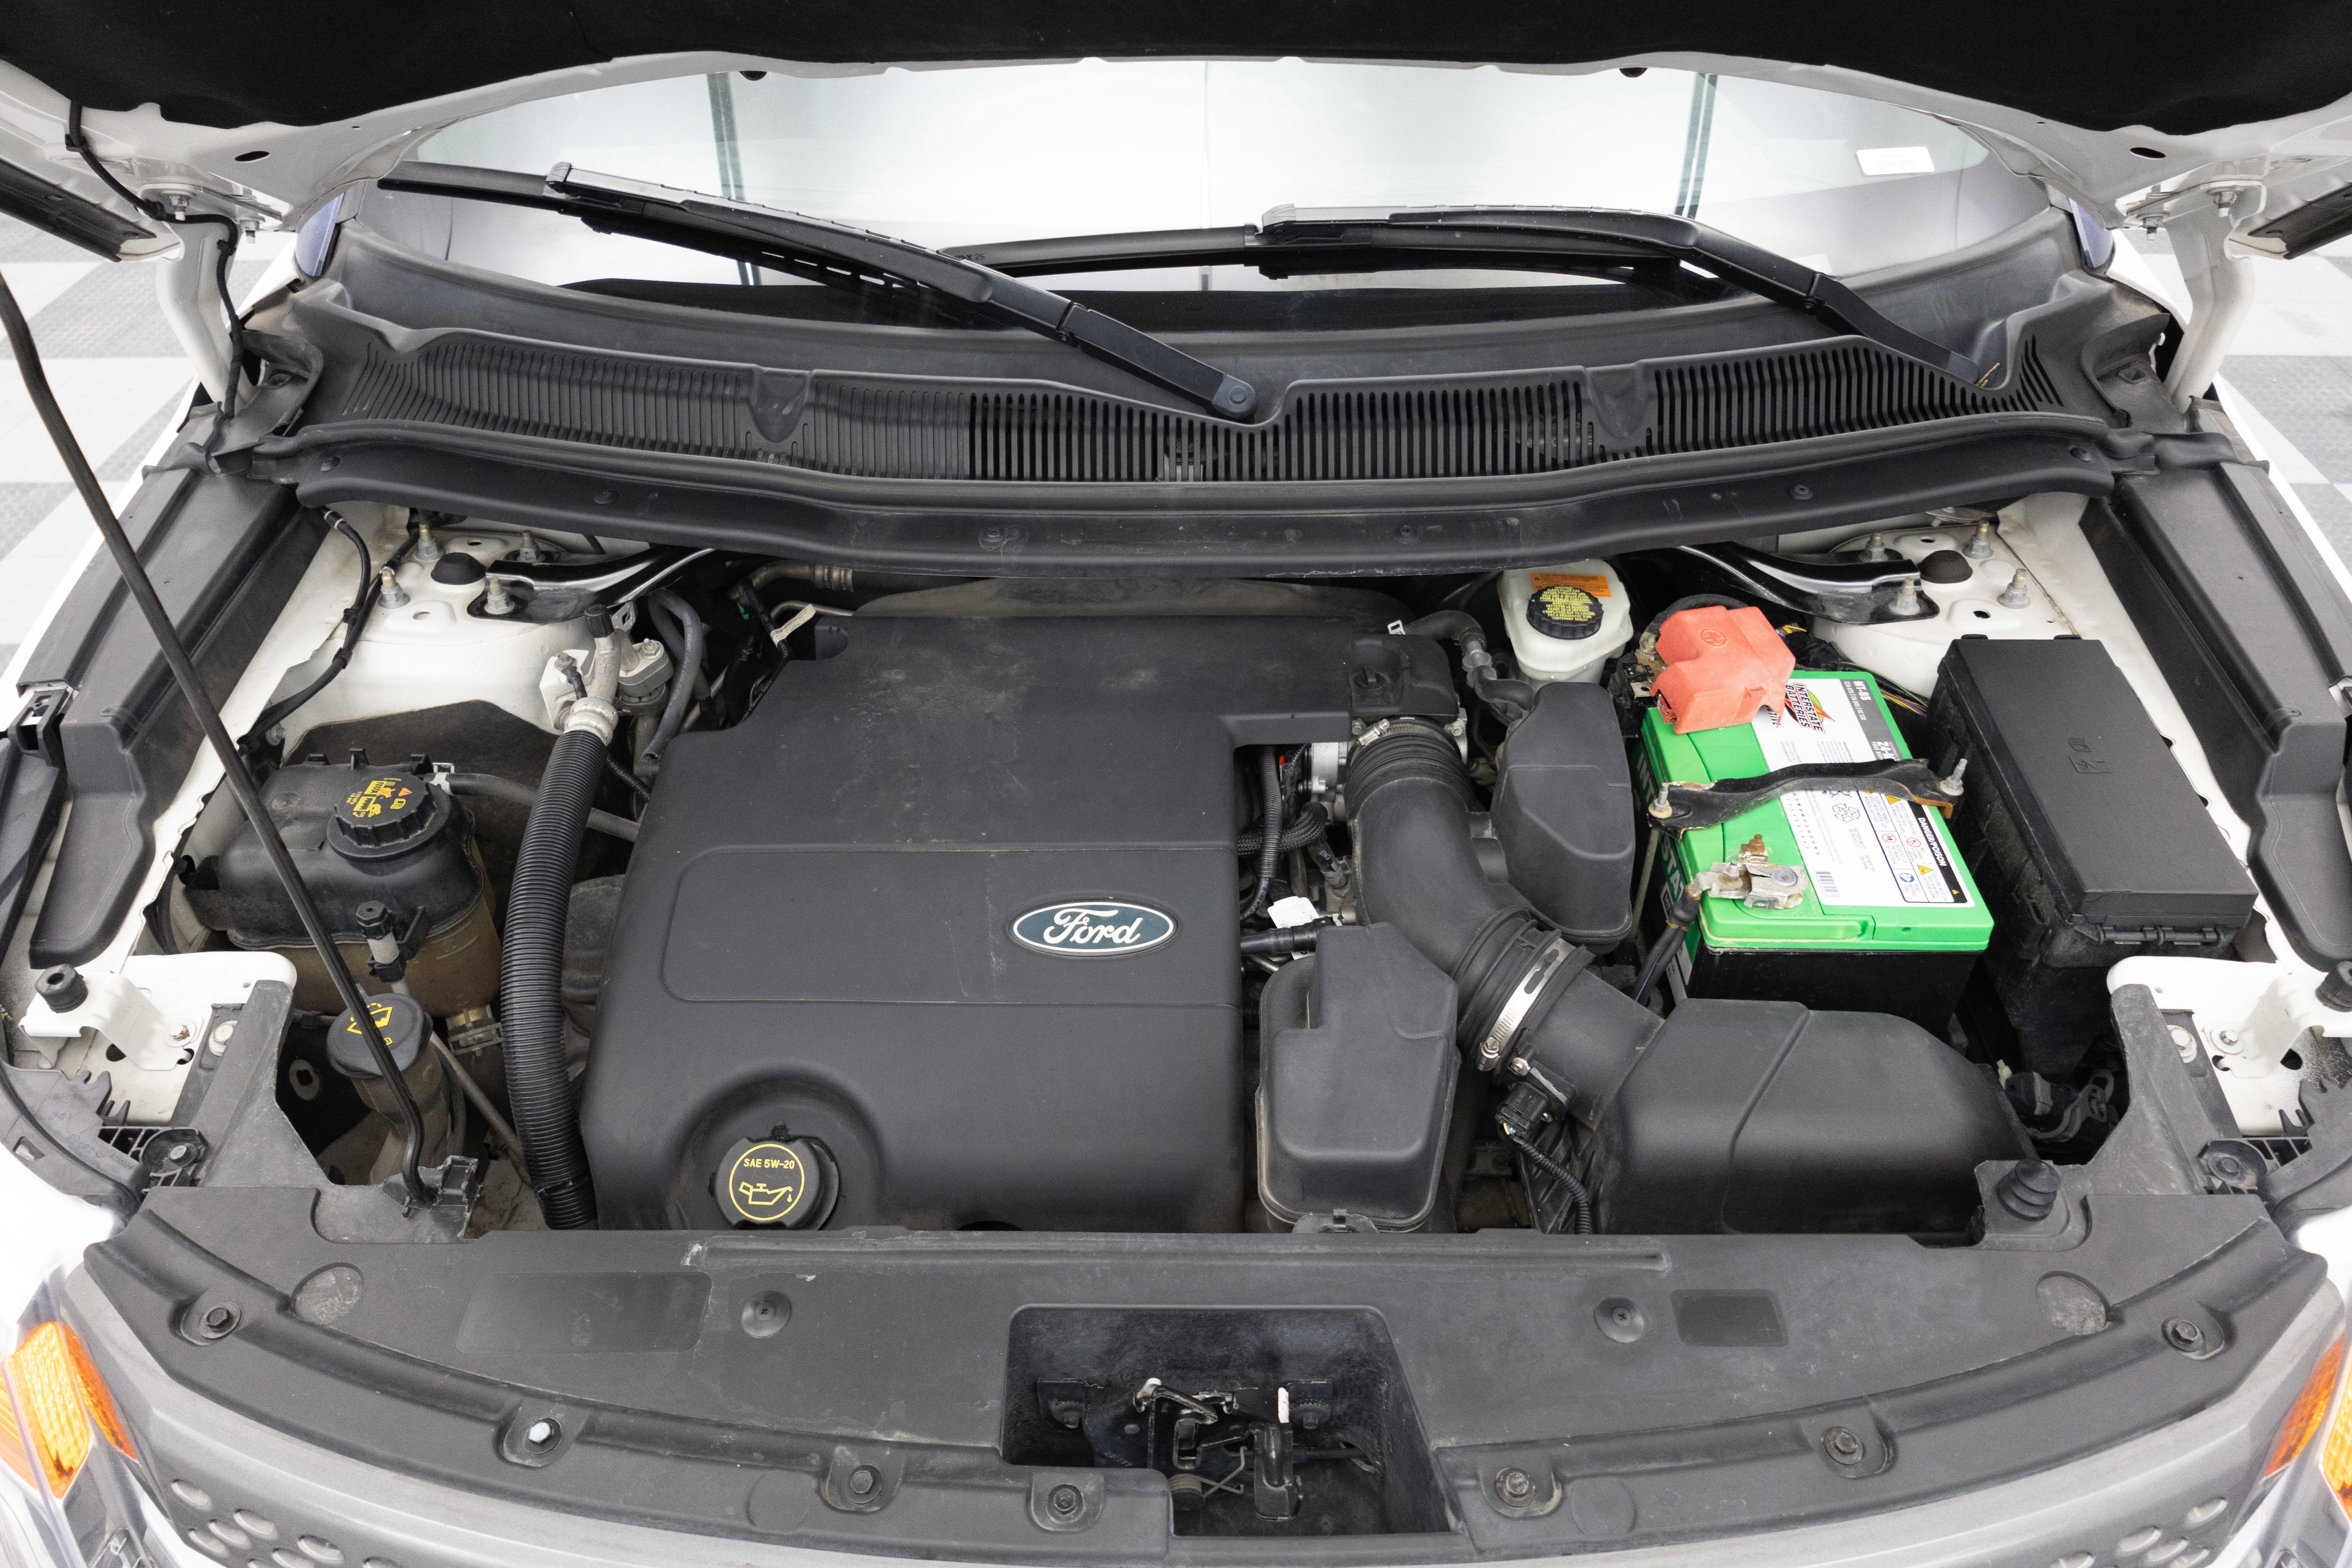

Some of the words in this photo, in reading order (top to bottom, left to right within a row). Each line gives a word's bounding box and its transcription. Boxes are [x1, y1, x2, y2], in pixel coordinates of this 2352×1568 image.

[1784, 685, 1811, 727] BATTERIES
[1794, 684, 1824, 731] INTERSTATE
[1852, 681, 1872, 700] MT-65
[1319, 850, 1331, 860] ENG
[1917, 817, 1947, 866] DANGER/POISON
[1043, 908, 1143, 944] Ford
[744, 1158, 762, 1168] SAE
[764, 1159, 795, 1169] 5W-20
